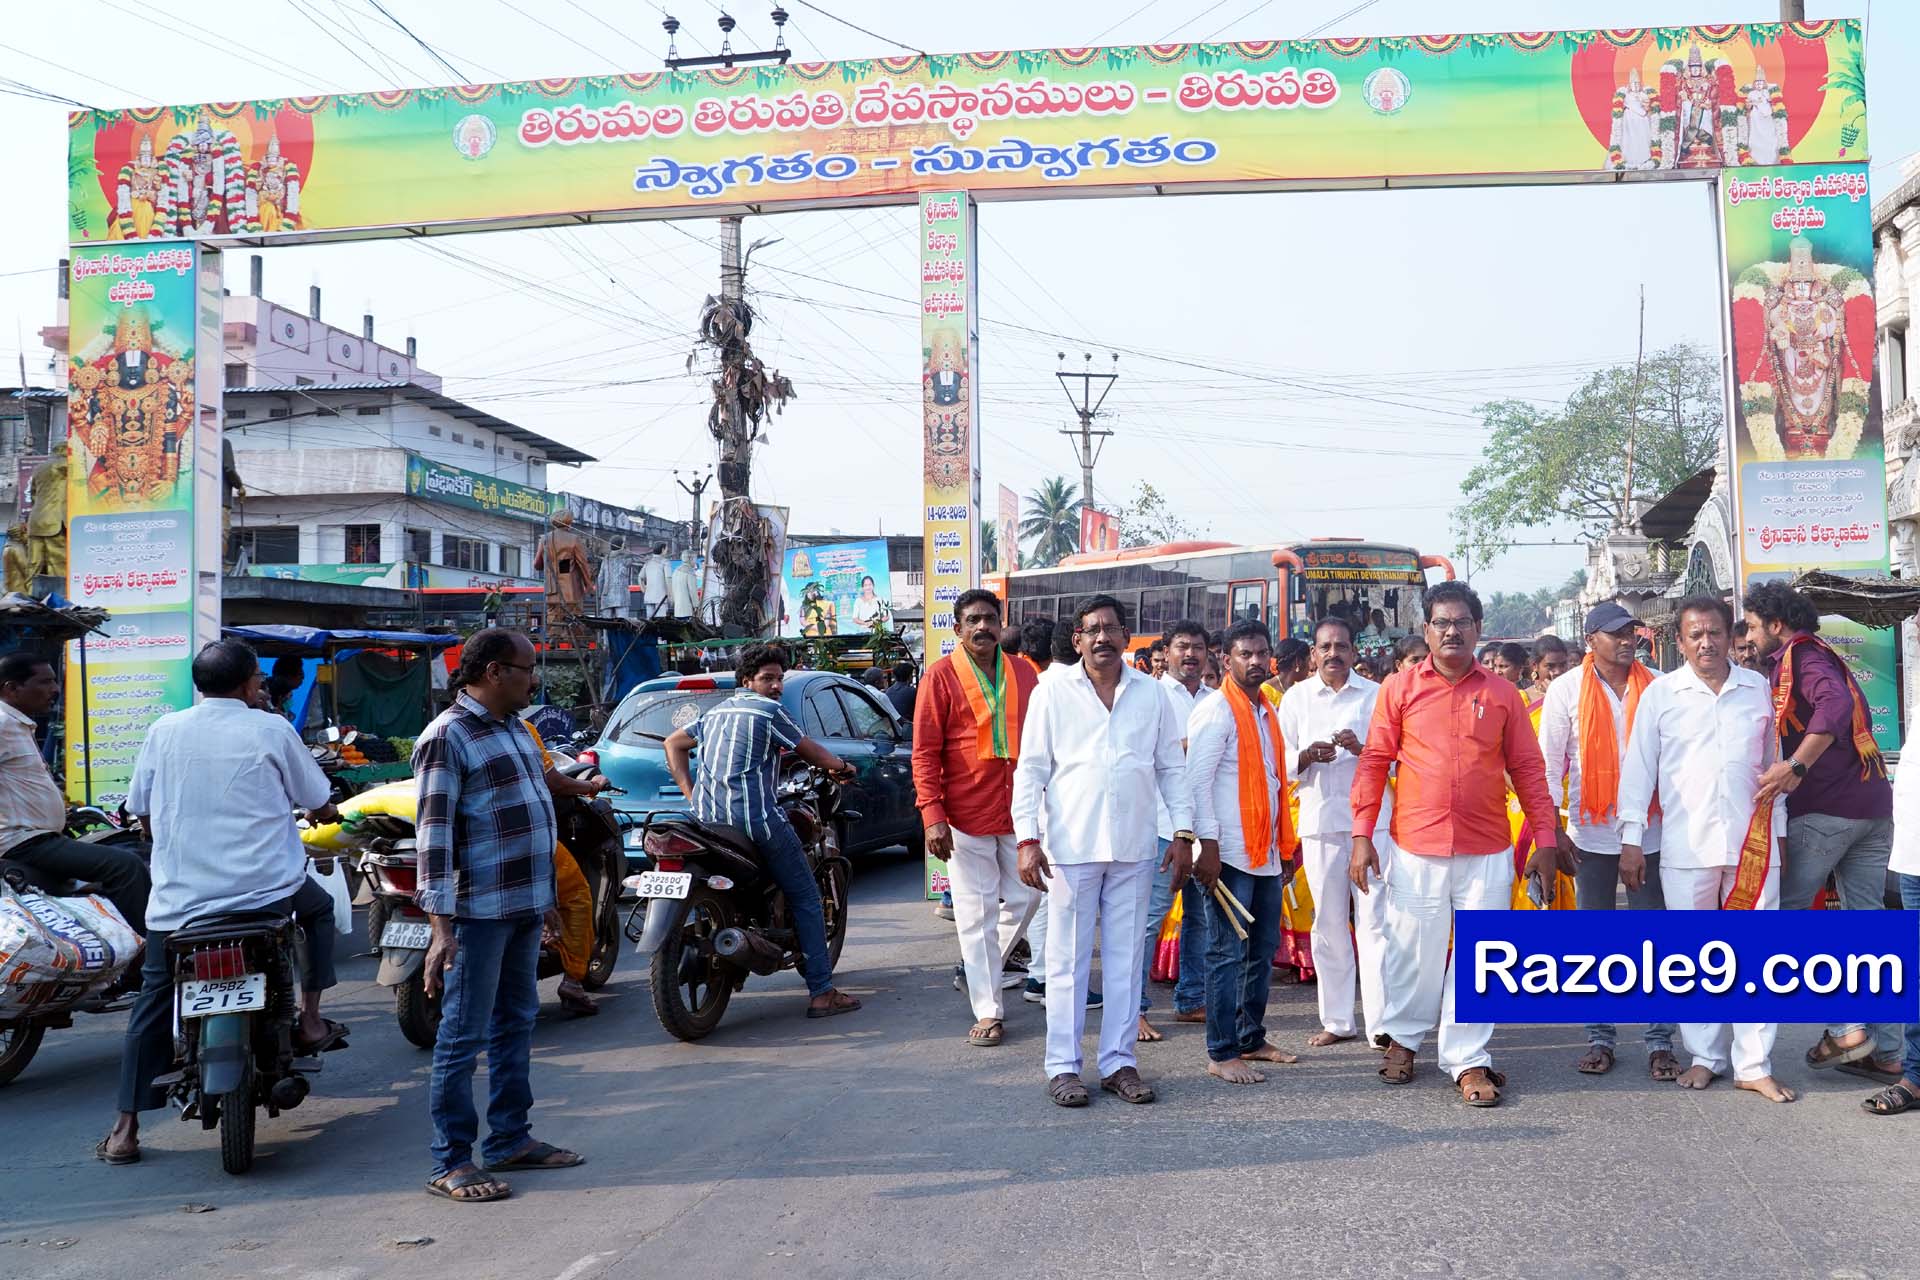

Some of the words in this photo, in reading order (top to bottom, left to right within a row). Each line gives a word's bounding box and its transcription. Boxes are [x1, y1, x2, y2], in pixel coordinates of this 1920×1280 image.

[521, 105, 683, 144] తిరుమల
[694, 93, 842, 134] తిరుపతి
[855, 79, 1133, 137] దేవస్థానములు
[1180, 72, 1337, 108] తిరుపతి
[636, 152, 857, 196] స్వాగతం
[914, 136, 1217, 178] సుస్వాగతం
[1729, 178, 1771, 204] శ్రీనివాస
[927, 505, 967, 521] 14-02-2026
[1330, 570, 1359, 580] TIRUPATI
[642, 883, 685, 896] 3961
[192, 991, 255, 1012] 215
